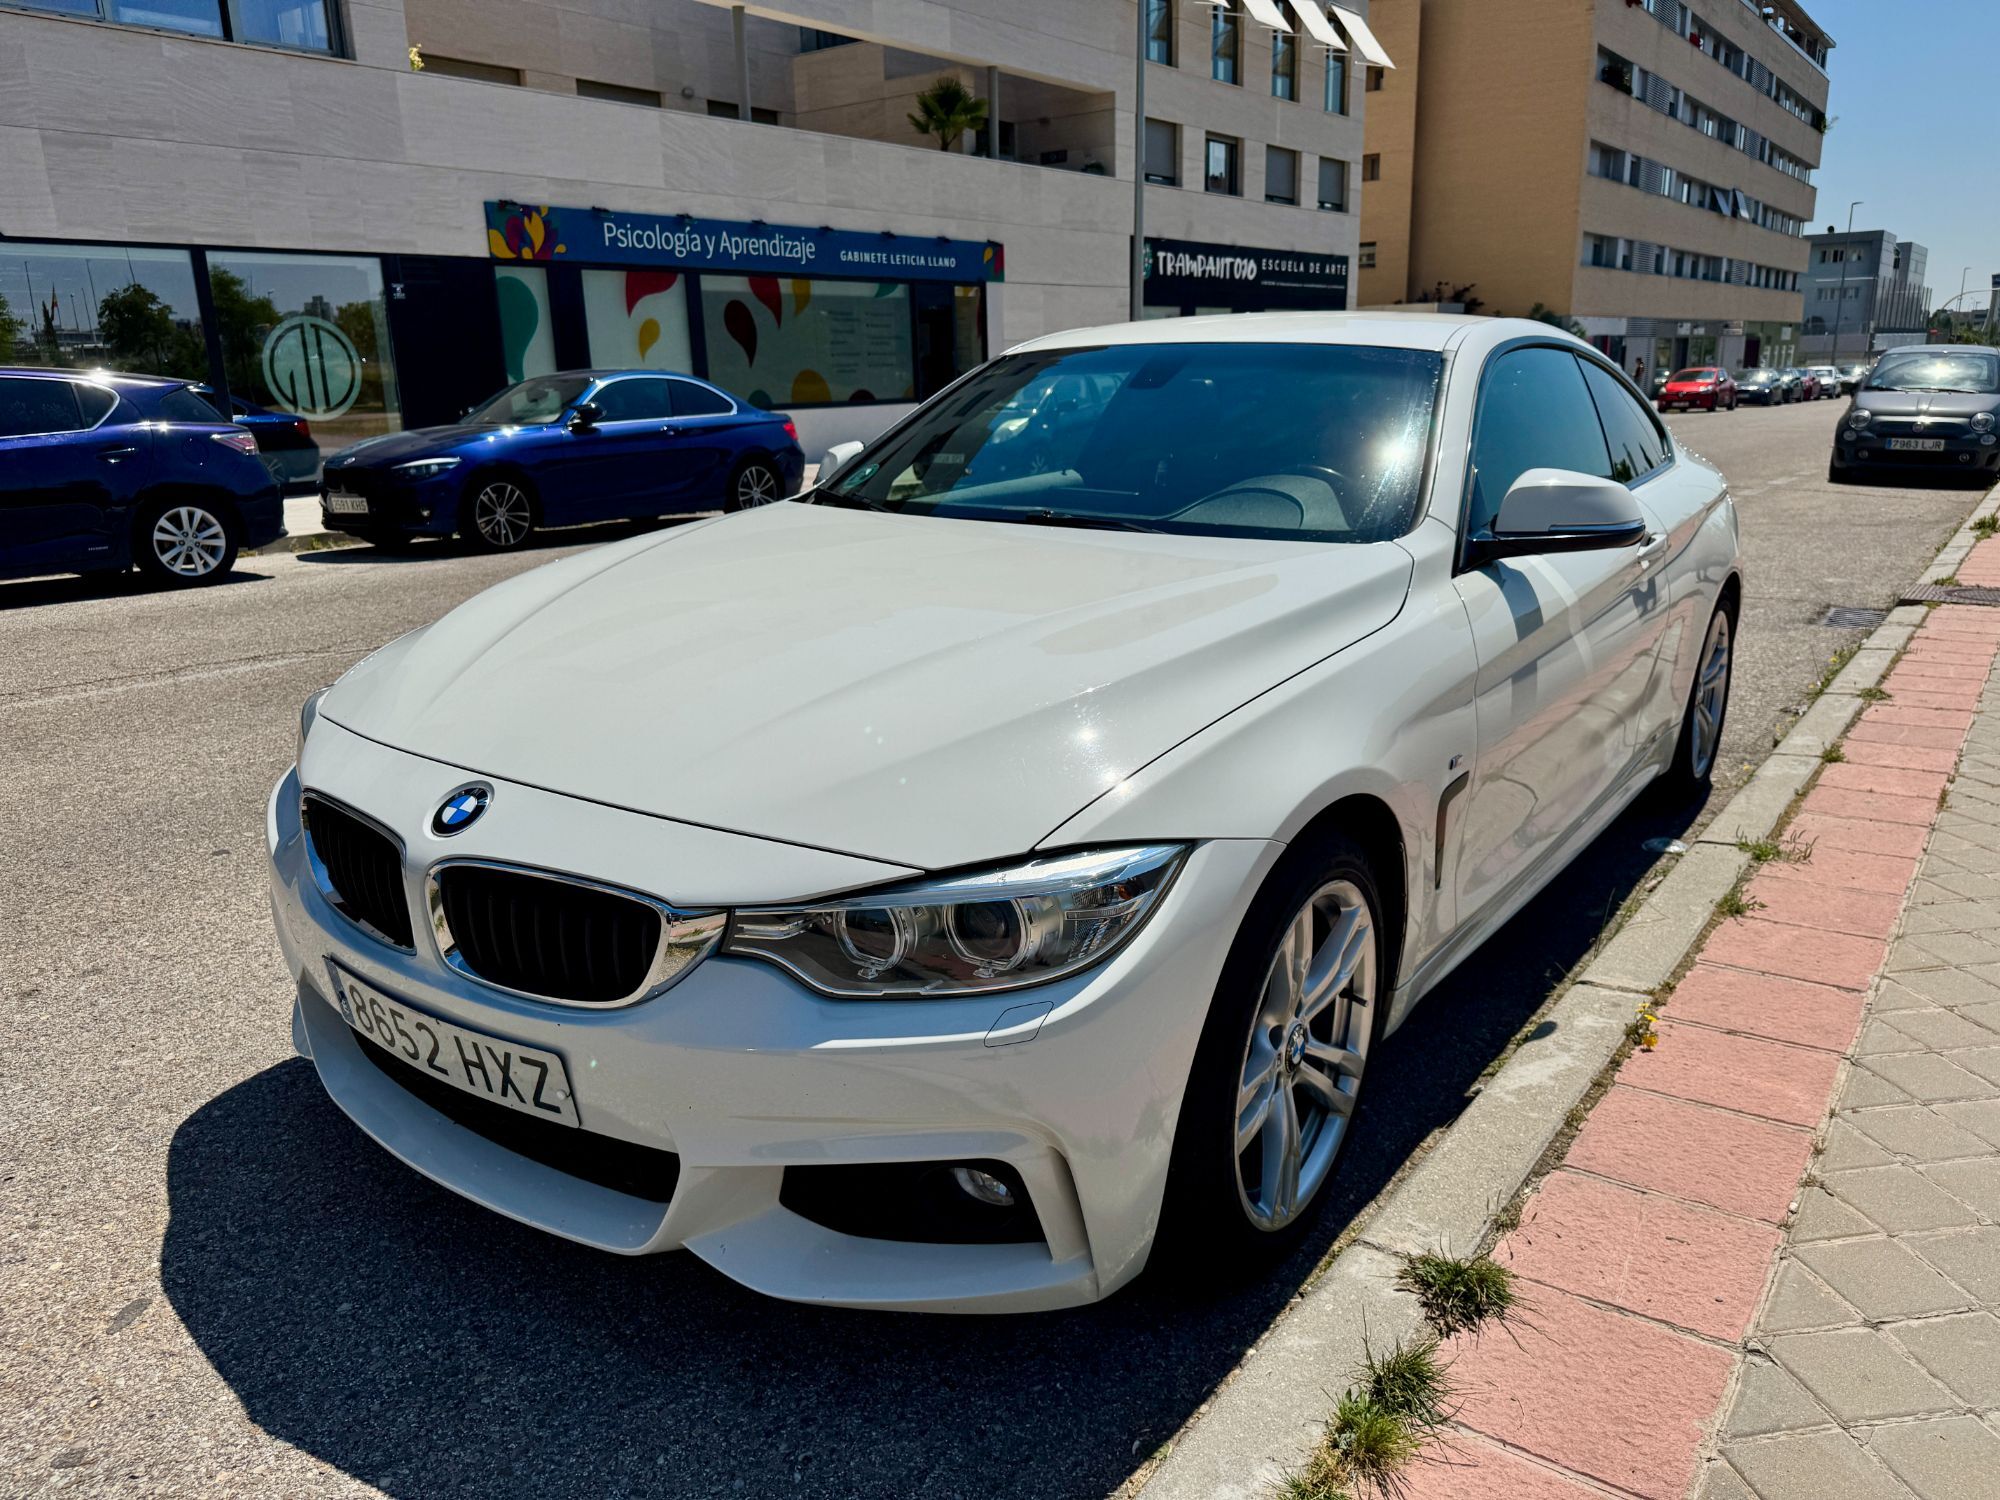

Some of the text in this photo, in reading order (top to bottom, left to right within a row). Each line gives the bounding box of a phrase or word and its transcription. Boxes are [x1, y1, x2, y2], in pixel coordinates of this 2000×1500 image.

[603, 222, 816, 264] Psicología y Aprendizaje
[840, 250, 957, 268] GABINETE LETICIA LLANO
[1261, 258, 1347, 276] ESCUELA DE ARTE
[348, 983, 562, 1114] 8652 HXZ
